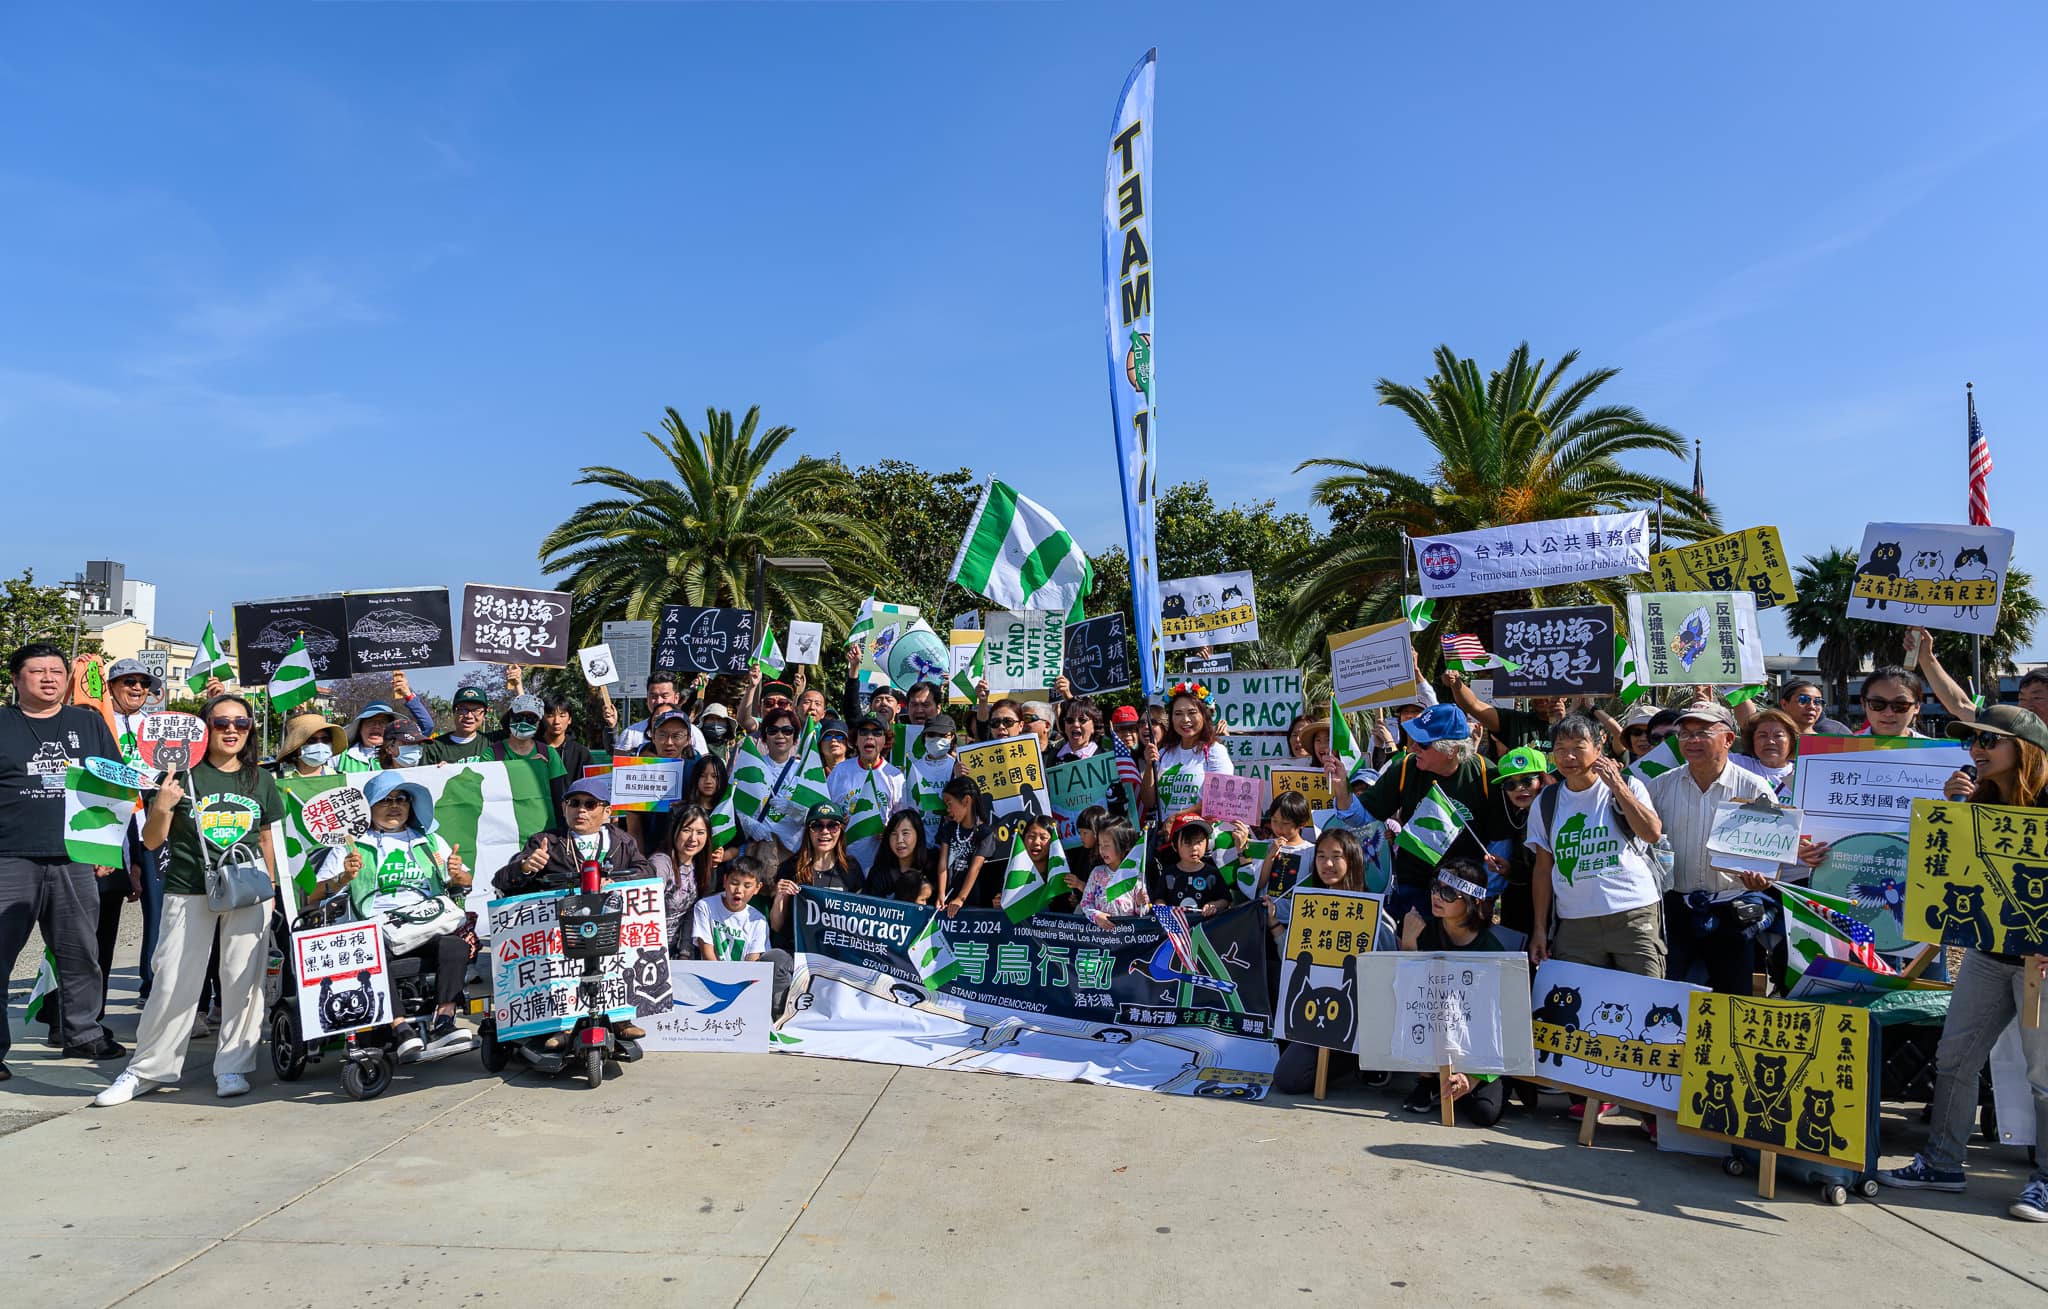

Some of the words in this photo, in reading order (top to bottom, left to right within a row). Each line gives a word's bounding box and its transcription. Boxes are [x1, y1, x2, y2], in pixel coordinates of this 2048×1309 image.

[1474, 527, 1642, 560] 台灣人公共事務會
[1470, 569, 1518, 582] Formosan
[1520, 564, 1573, 578] Association
[1575, 561, 1588, 572] for
[1591, 558, 1618, 570] Public
[473, 594, 565, 625] 沒有討論
[475, 623, 557, 656] 沒有民主
[658, 608, 679, 667] 反黑箱
[1504, 617, 1607, 653] 沒有討論
[1647, 602, 1668, 675] 反擴權濫法
[1716, 602, 1736, 674] 反黑箱暴力
[988, 641, 1004, 666] WE
[1006, 623, 1025, 677] STAND
[1027, 628, 1042, 669] WITH
[1043, 610, 1064, 688] DEMOCRACY
[1243, 675, 1299, 694] WITH
[147, 727, 203, 740] 黑箱國會
[149, 716, 197, 728] 我喵視
[969, 744, 1028, 769] 我喵視
[1261, 742, 1284, 757] LA
[977, 763, 1037, 792] 黑箱國會
[1160, 773, 1193, 783] TEAM
[1279, 775, 1329, 791] 我喵視
[1866, 768, 1891, 784] Los
[1897, 770, 1942, 788] Angeles
[1065, 793, 1092, 807] WITH
[1158, 784, 1199, 795] TAIWAN
[1828, 791, 1945, 810] 我反對國會
[303, 787, 364, 821] 沒有討論
[310, 804, 366, 833] 不是民主
[212, 827, 237, 838] 2024
[1559, 825, 1609, 844] TEAM
[1718, 826, 1795, 851] TAIWAN
[1556, 840, 1618, 860] TAIWAN
[1831, 862, 1859, 871] HANDS
[1879, 868, 1906, 877] CHINA
[825, 898, 841, 910] WE
[843, 901, 877, 916] STAND
[879, 905, 905, 921] WITH
[1301, 898, 1365, 921] 我喵視
[806, 899, 912, 946] Democracy
[961, 921, 973, 934] 2.
[974, 921, 1002, 935] 2024
[1032, 916, 1058, 928] Federal
[1058, 919, 1085, 932] Building
[310, 931, 367, 952] 我喵視
[823, 930, 888, 956] 民主站出來
[1059, 932, 1076, 942] Blvd,
[1077, 933, 1090, 942] Los
[1091, 935, 1122, 946] Angeles,
[1124, 935, 1136, 944] CA
[1300, 928, 1371, 954] 黑箱國會
[304, 947, 365, 973] 黑箱國會
[862, 958, 889, 974] STAND
[889, 965, 910, 979] WITH
[951, 940, 1116, 990] 青鳥行動
[1428, 972, 1454, 986] KEEP
[950, 985, 977, 1000] STAND
[978, 992, 998, 1004] WITH
[998, 996, 1048, 1012] DEMOCRACY
[1074, 992, 1115, 1008] 洛杉磯
[1418, 986, 1466, 1001] TAIWAN
[1128, 1007, 1177, 1025] 青鳥行動
[1182, 1010, 1234, 1028] 守護民主
[1242, 1019, 1264, 1034] 聯盟
[1744, 1028, 1808, 1050] 不是民主
[1836, 1013, 1857, 1090] 反黑箱
